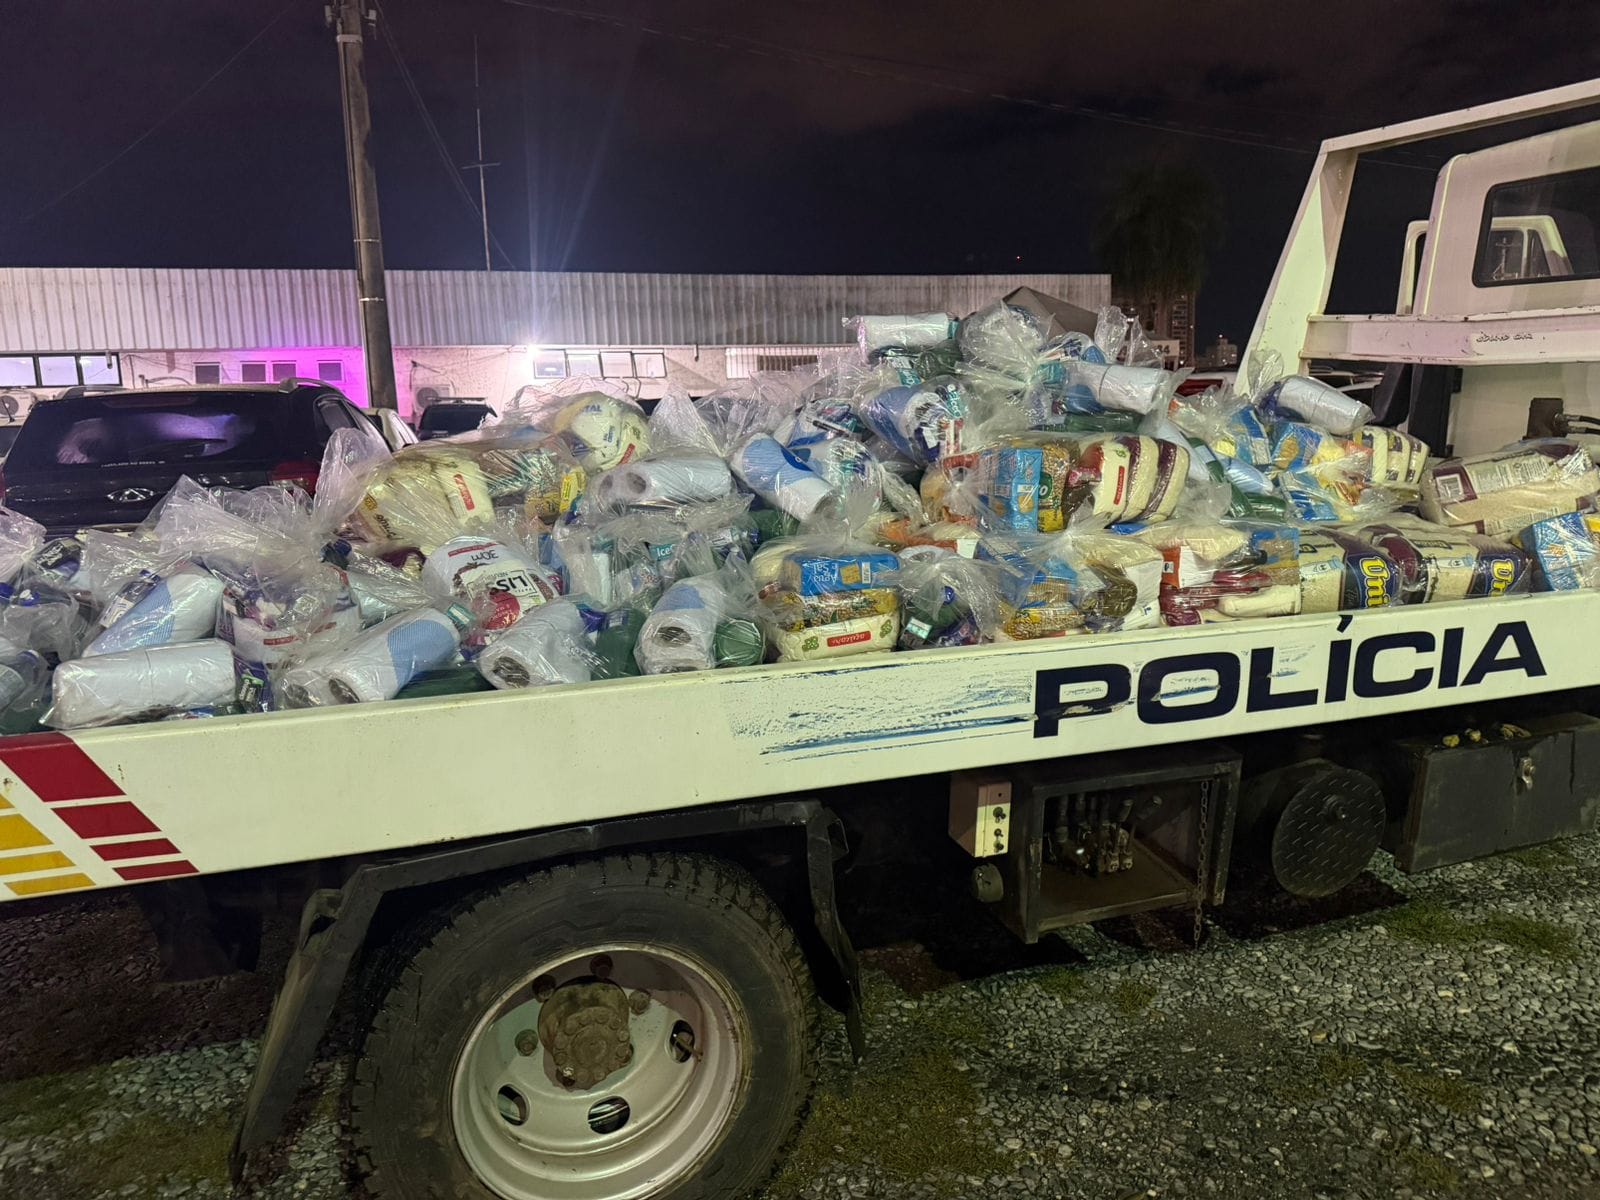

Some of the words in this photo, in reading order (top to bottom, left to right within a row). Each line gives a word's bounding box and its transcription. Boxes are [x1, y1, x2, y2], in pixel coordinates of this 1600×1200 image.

[470, 549, 499, 561] 30m
[812, 561, 829, 575] Sal
[1034, 614, 1548, 738] POLÍCIA
